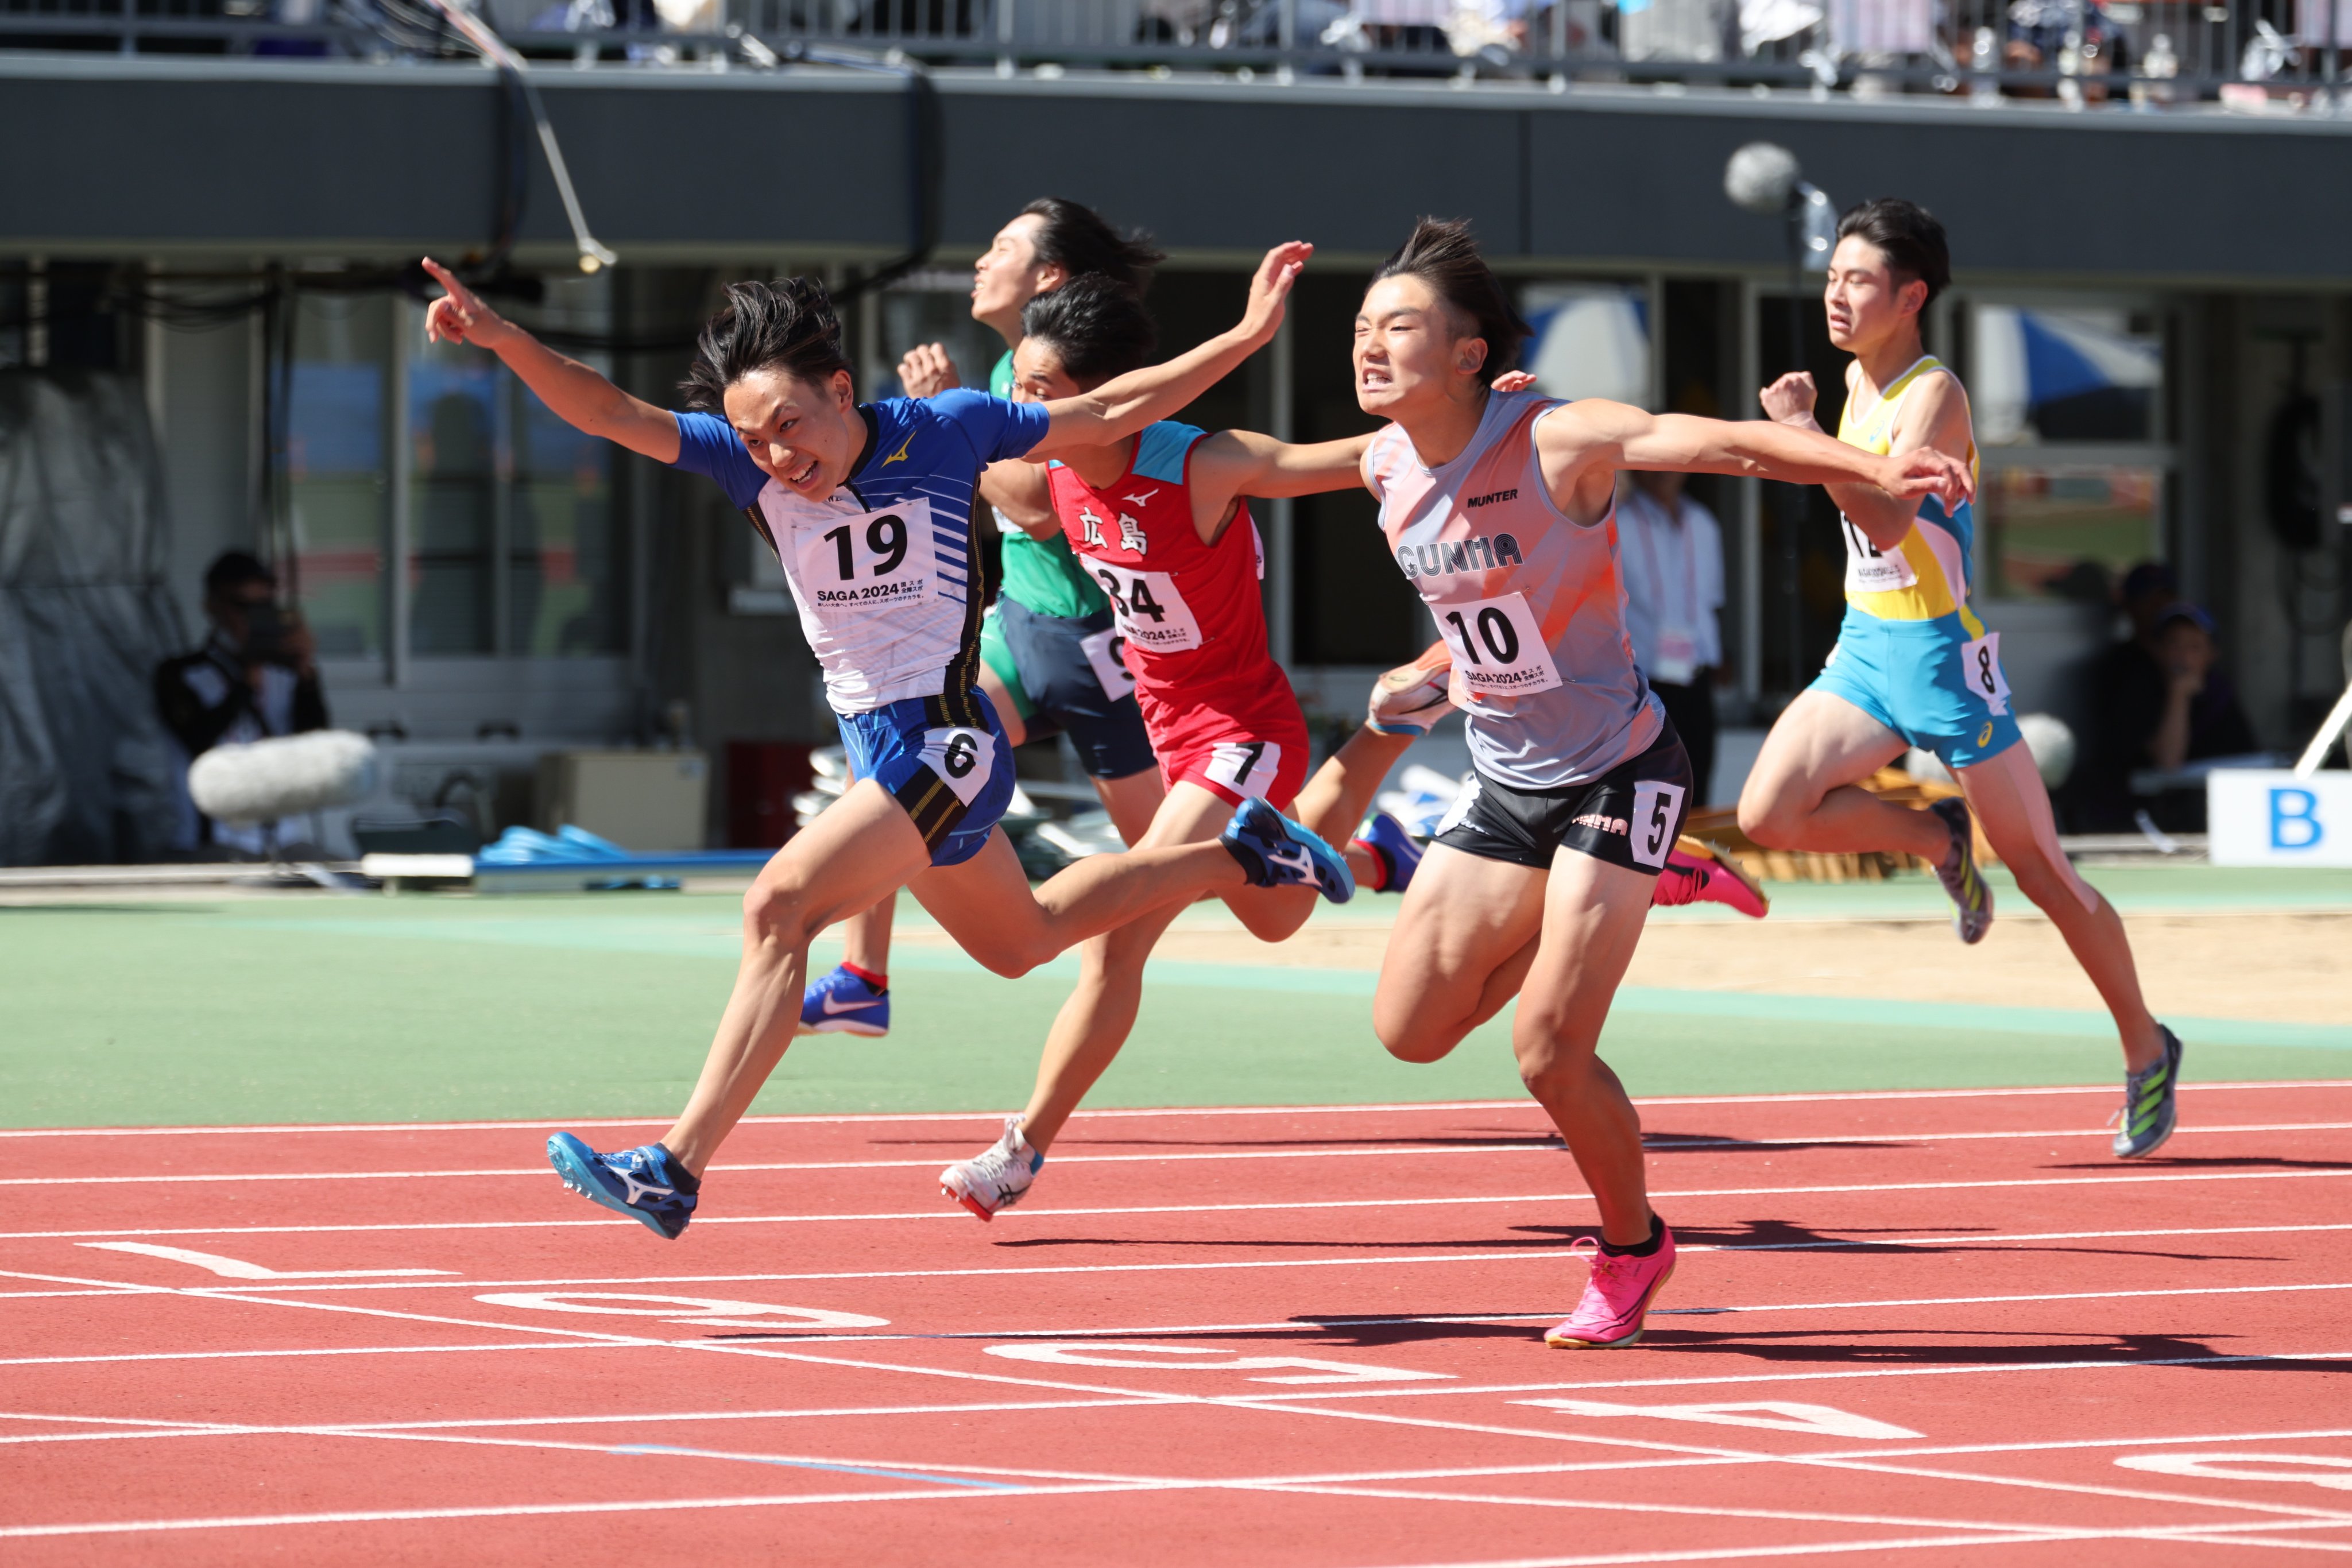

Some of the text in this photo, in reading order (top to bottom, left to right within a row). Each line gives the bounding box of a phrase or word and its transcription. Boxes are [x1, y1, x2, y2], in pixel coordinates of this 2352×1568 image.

[1468, 489, 1518, 508] MUNTER
[823, 514, 908, 581] 19
[1079, 506, 1147, 556] 広島
[1396, 533, 1525, 580] GUNMA
[817, 583, 899, 602] SAGA 2024
[1097, 568, 1166, 623] 34
[1445, 607, 1519, 665] 10
[1465, 670, 1522, 684] SAGA 2024
[1976, 645, 1995, 694] 8
[944, 733, 978, 779] 6
[1233, 741, 1266, 787] 7
[1647, 792, 1672, 855] 5
[2269, 788, 2323, 849] B
